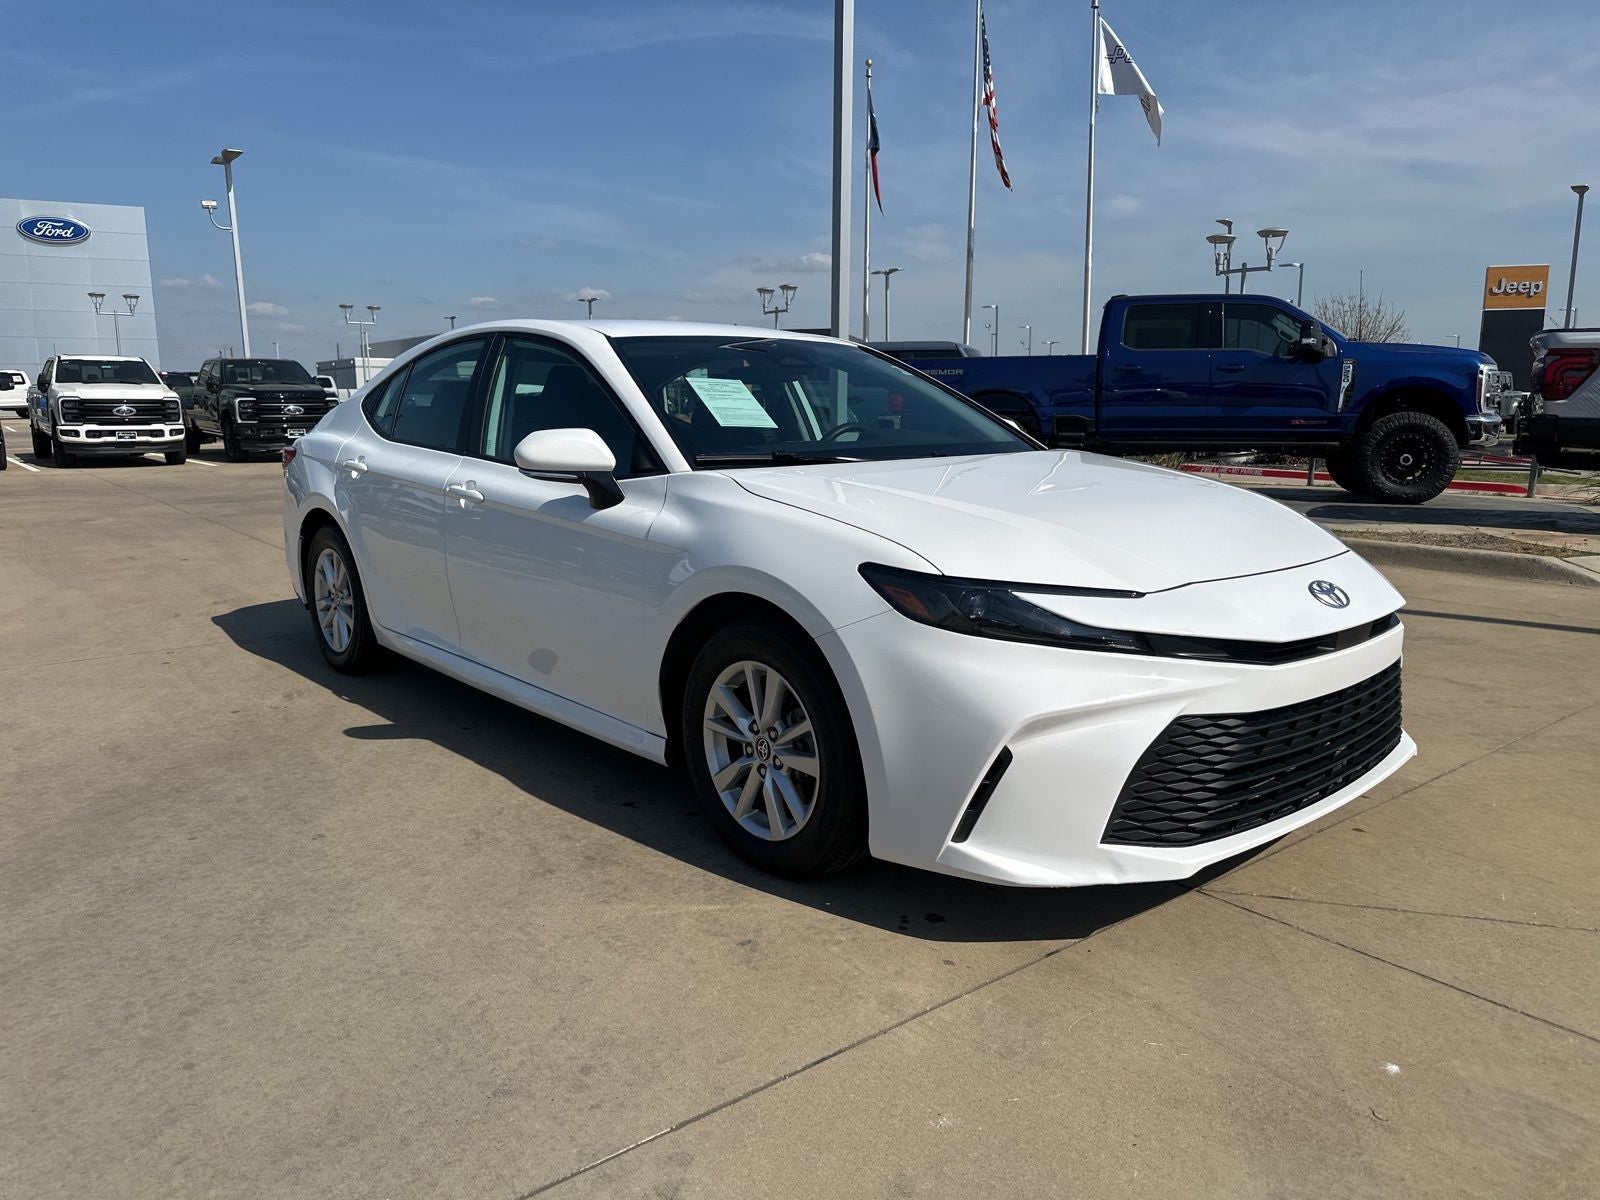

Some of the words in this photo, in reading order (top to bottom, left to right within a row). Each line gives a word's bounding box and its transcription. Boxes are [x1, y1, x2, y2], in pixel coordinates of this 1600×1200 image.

[33, 220, 75, 238] Ford
[1491, 277, 1543, 297] Jeep
[1240, 468, 1263, 476] PARKING
